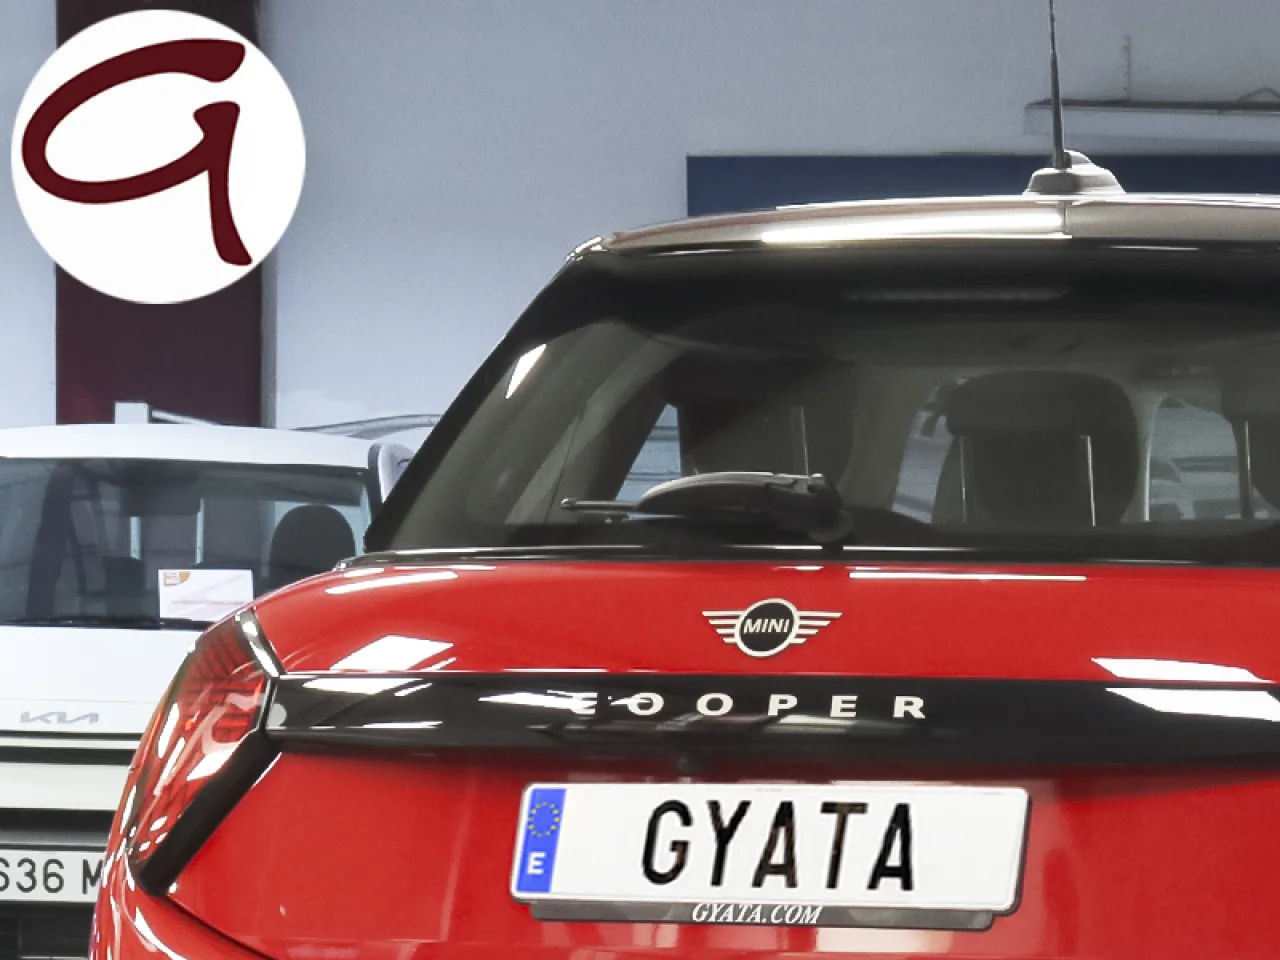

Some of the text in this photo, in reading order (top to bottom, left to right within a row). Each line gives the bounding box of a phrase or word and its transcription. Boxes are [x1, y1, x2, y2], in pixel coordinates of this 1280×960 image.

[743, 618, 789, 633] MINI
[641, 799, 914, 891] GYATA
[527, 852, 546, 874] E
[692, 903, 822, 924] GYATA.COM
